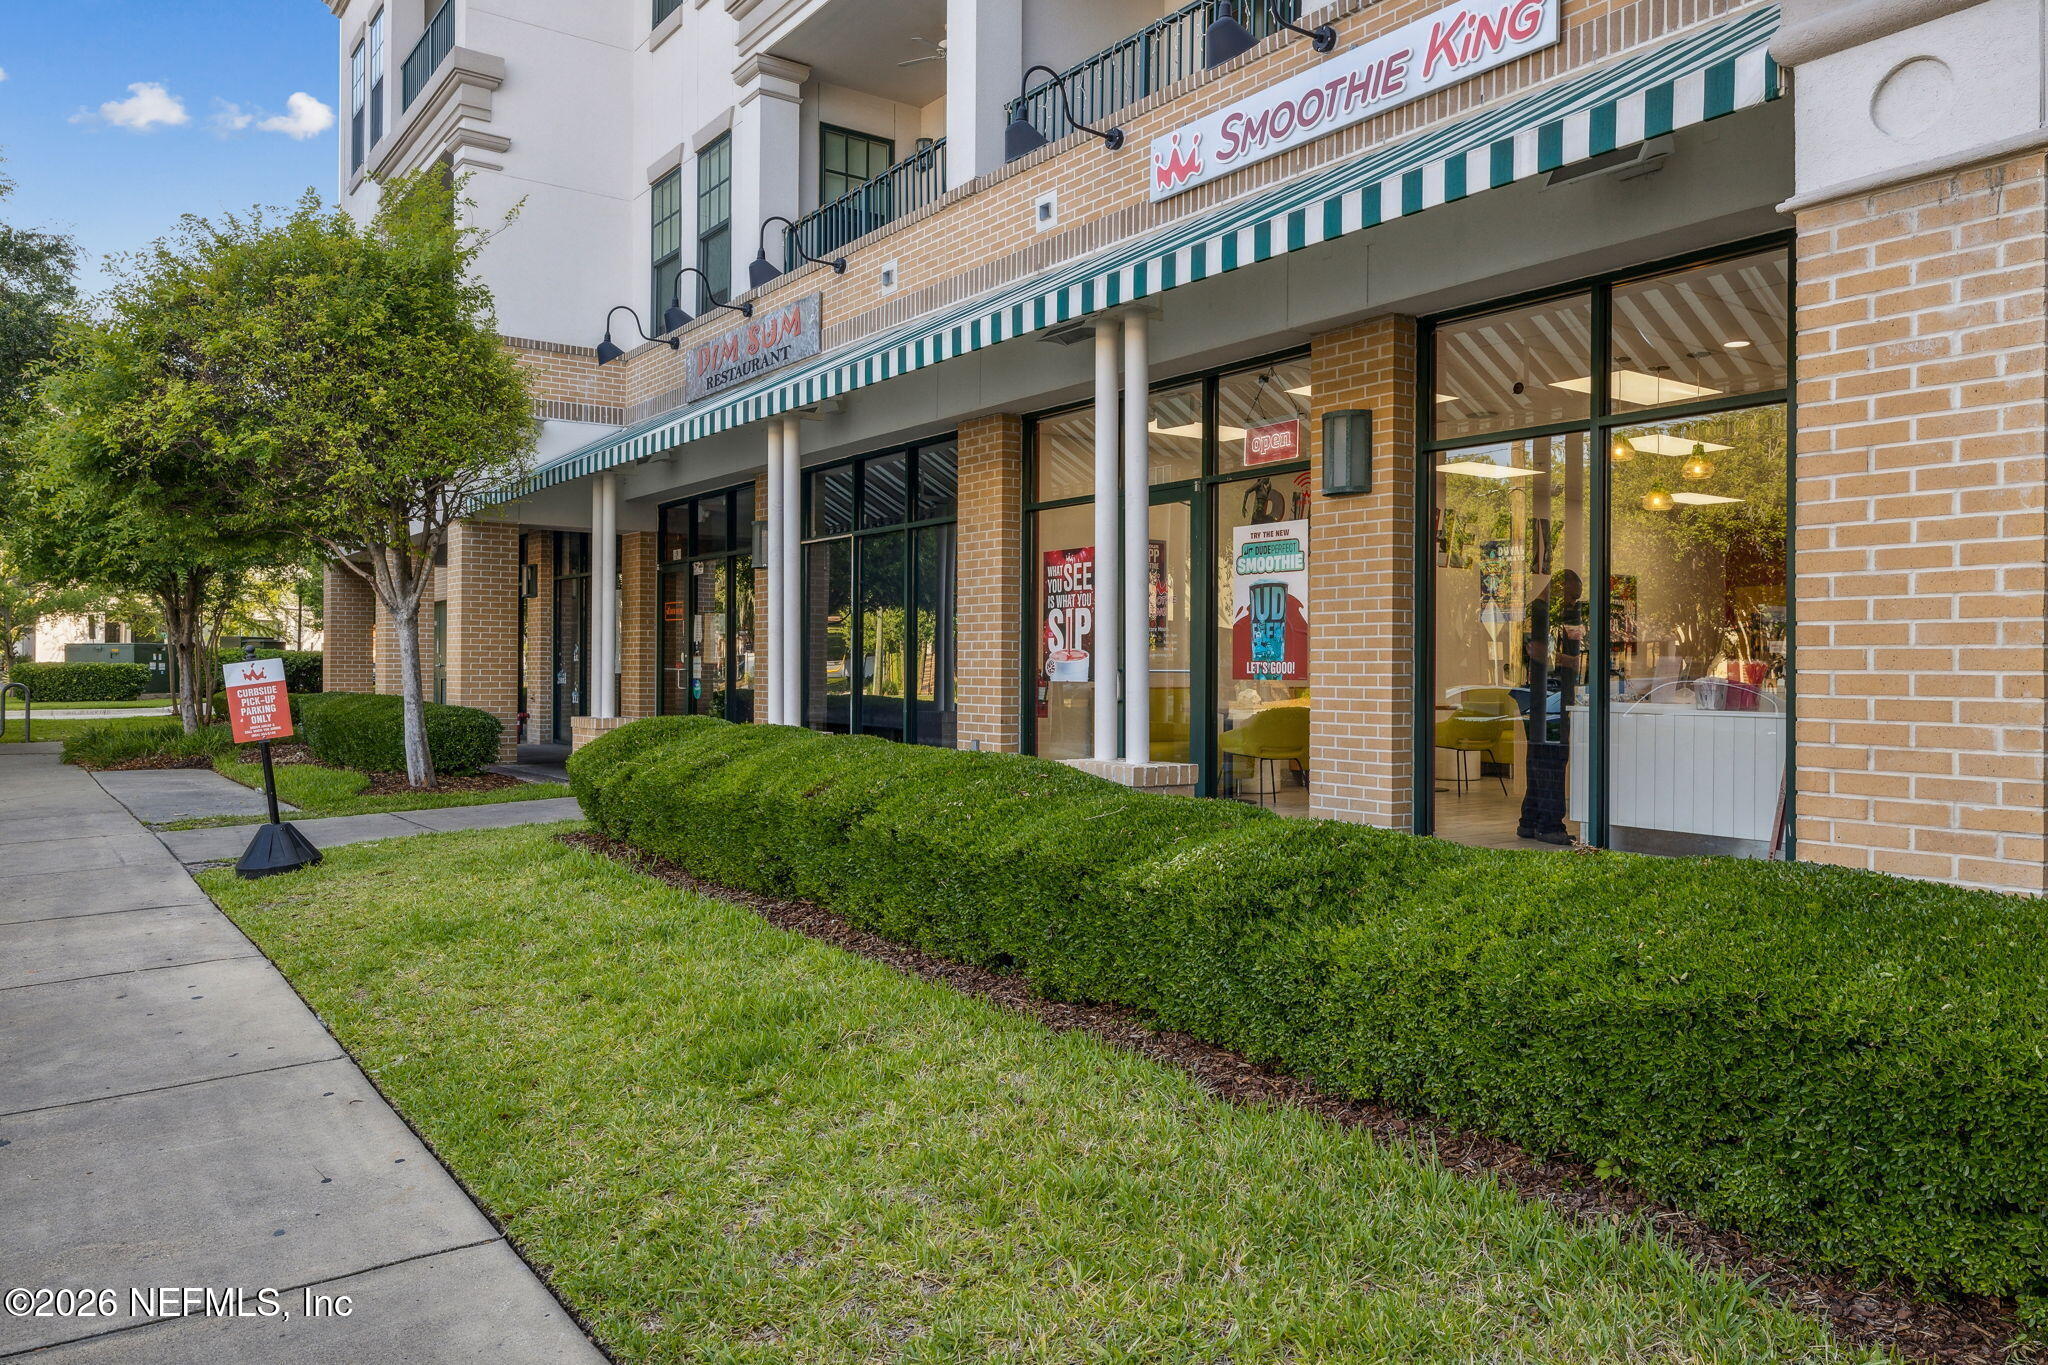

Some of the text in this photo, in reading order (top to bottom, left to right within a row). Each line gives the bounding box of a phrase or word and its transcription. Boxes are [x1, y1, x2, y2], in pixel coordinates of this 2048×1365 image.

[1216, 50, 1411, 161] SMOOTHIE
[696, 305, 802, 377] DIM SUM
[706, 345, 791, 390] RESTAURANT
[1252, 431, 1291, 455] open
[1250, 529, 1290, 540] TRY THE NEW
[1047, 564, 1063, 577] WHAT
[1237, 553, 1304, 574] SMOOTHIE
[1047, 561, 1093, 593] YOU SEE
[1047, 592, 1092, 608] IS WHAT YOU
[1047, 608, 1092, 653] SIP
[1246, 661, 1295, 674] LET'S GOOO!
[237, 685, 277, 698] CURBSIDE
[241, 694, 276, 707] PICK-UP
[240, 704, 277, 716] PARKING
[251, 714, 271, 724] ONLY
